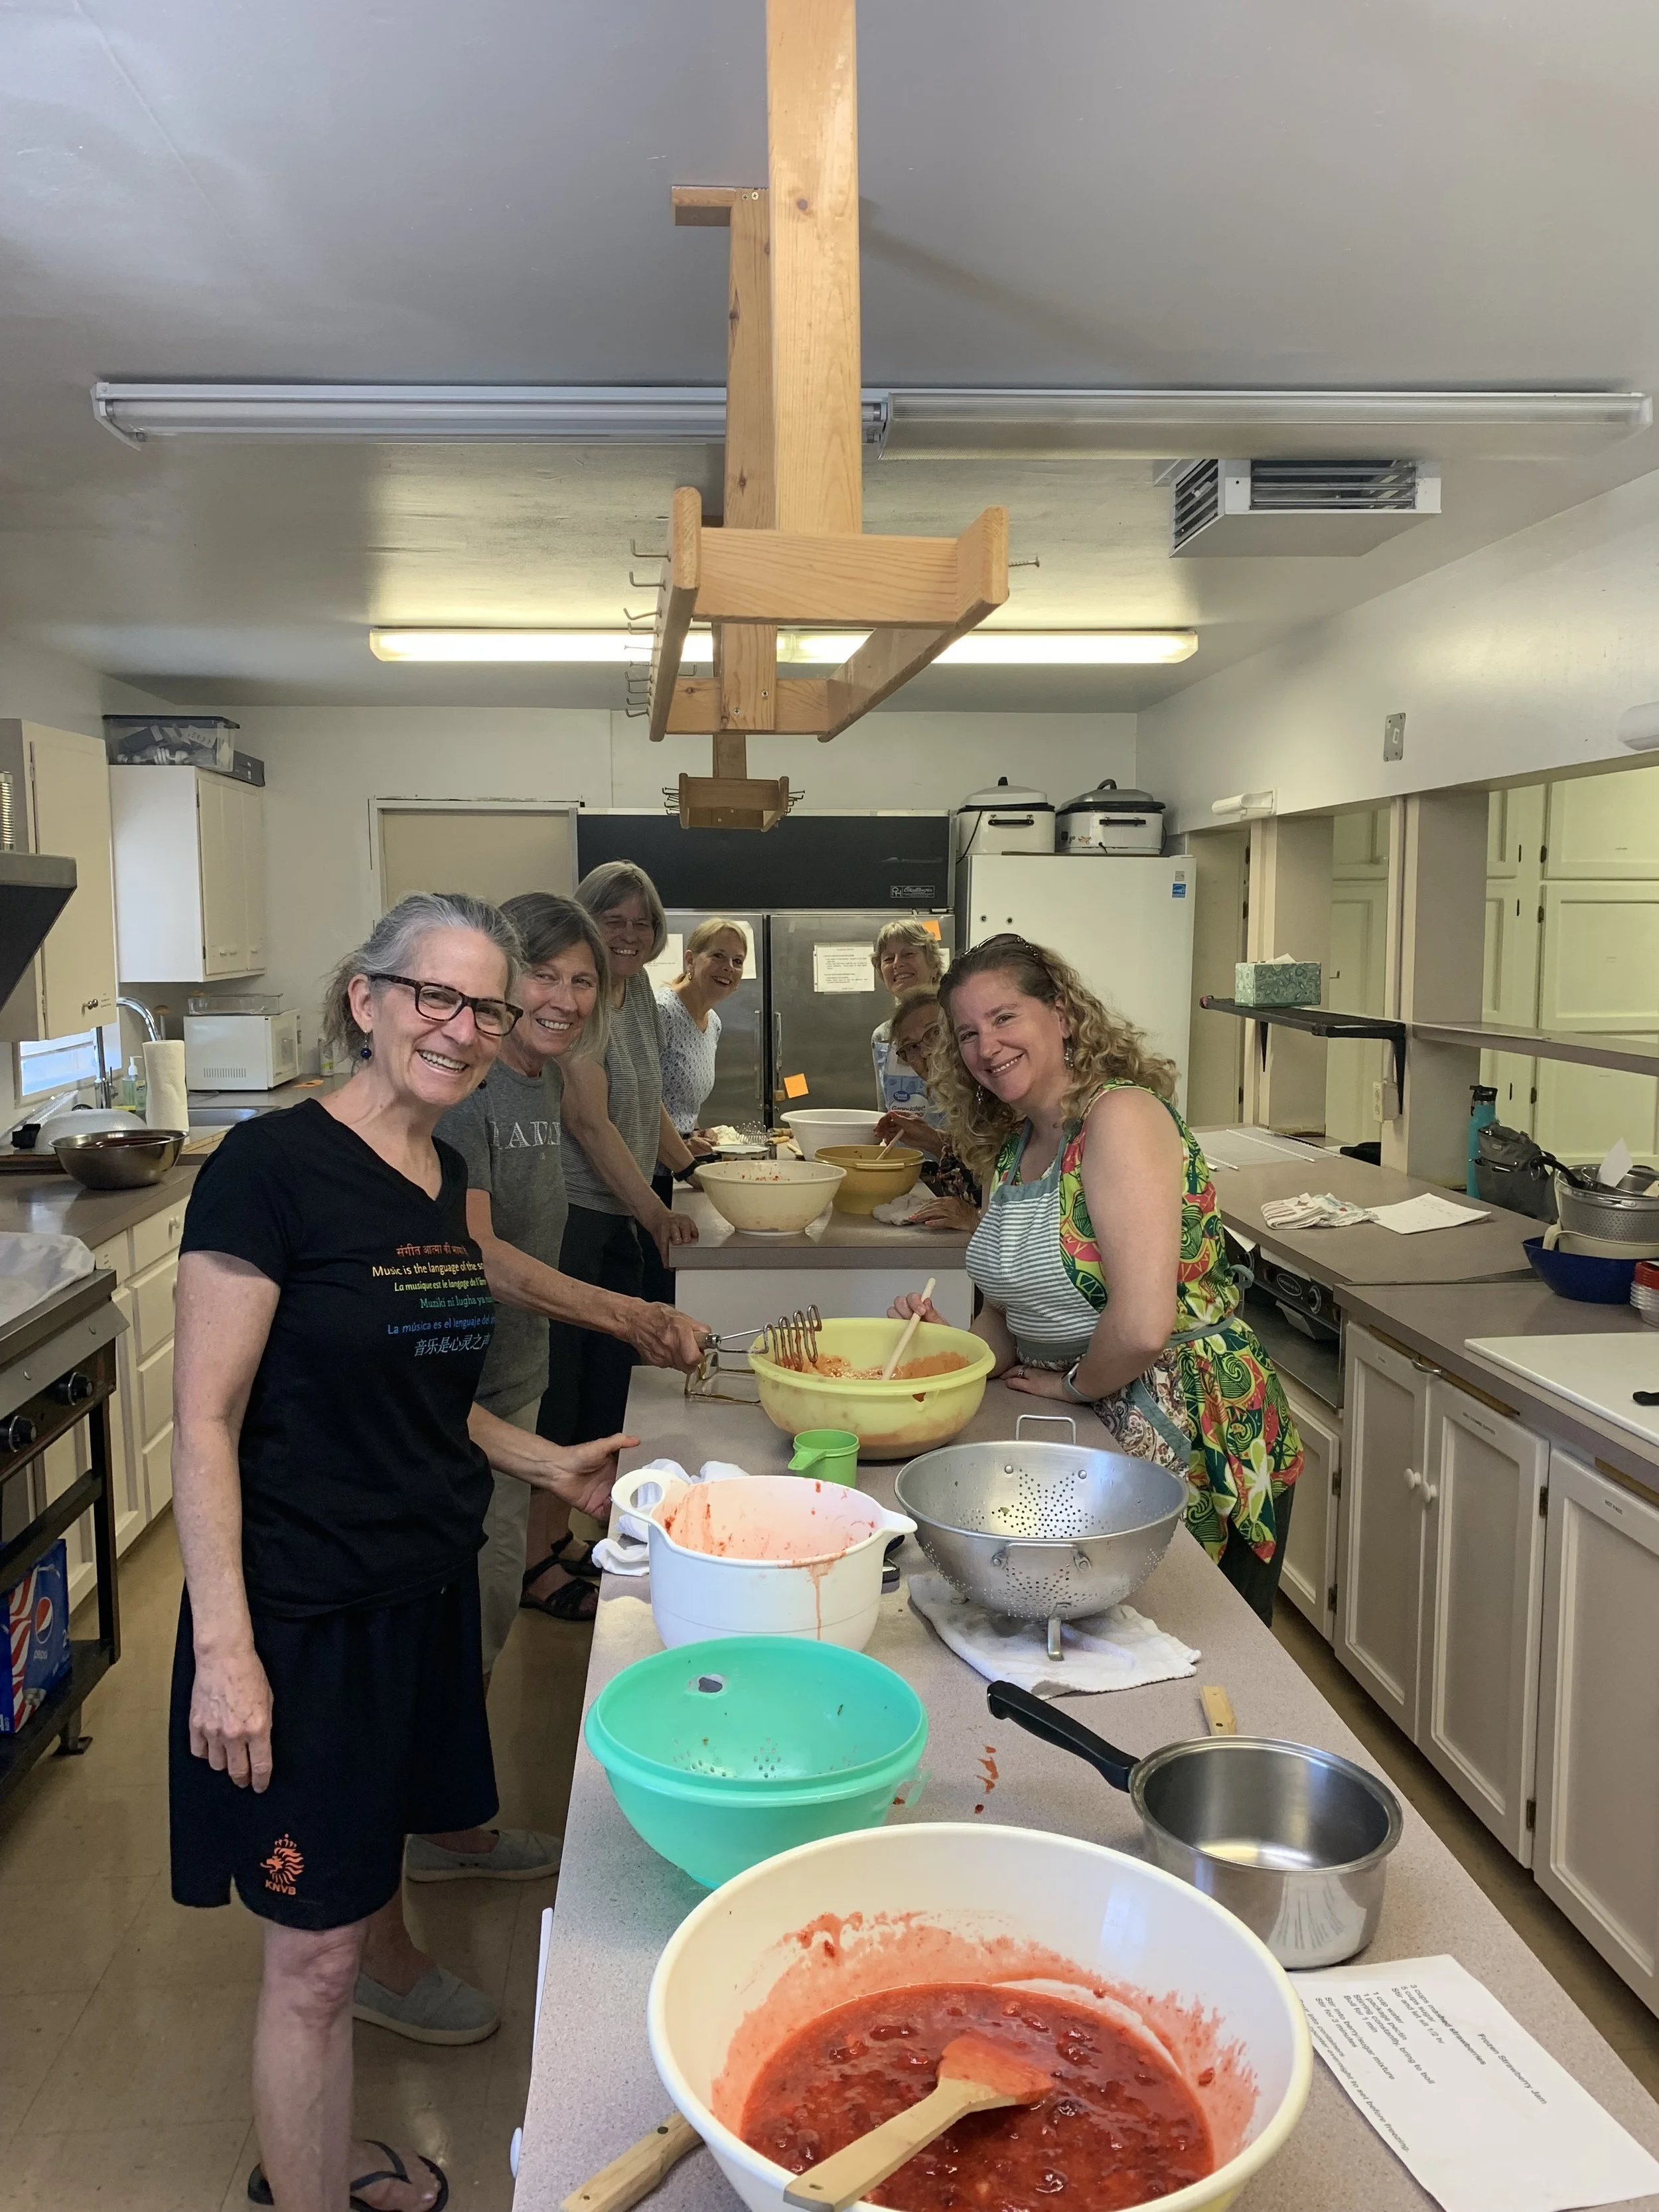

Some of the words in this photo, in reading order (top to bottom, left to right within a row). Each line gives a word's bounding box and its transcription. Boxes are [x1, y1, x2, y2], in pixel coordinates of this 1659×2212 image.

[372, 1266, 402, 1278] Music
[403, 1266, 412, 1275] is
[413, 1263, 428, 1274] the
[428, 1262, 459, 1276] language
[460, 1261, 467, 1272] of
[466, 1260, 477, 1271] the
[394, 1282, 404, 1292] La
[405, 1281, 432, 1291] musique
[442, 1280, 448, 1288] le
[449, 1280, 469, 1290] langage
[470, 1278, 476, 1287] de
[420, 1297, 446, 1309] Muziki
[447, 1297, 455, 1307] ni
[455, 1295, 477, 1307] lugha
[477, 1297, 486, 1306] ya
[388, 1324, 399, 1335] La
[402, 1322, 431, 1333] música
[444, 1317, 452, 1328] el
[453, 1316, 480, 1329] lenguaje
[482, 1313, 490, 1325] del
[414, 1333, 491, 1357] 音乐是心灵之声
[265, 1880, 297, 1895] KNVB
[1315, 1998, 1327, 2008] Stir
[1324, 2008, 1334, 2018] for
[1335, 2024, 1358, 2048] minutes
[1344, 1995, 1357, 2007] Boil
[1354, 2007, 1364, 2017] for
[1366, 2022, 1378, 2033] min
[1365, 1998, 1391, 2022] package
[1387, 2022, 1407, 2041] pectin
[1376, 1996, 1388, 2008] cup
[1387, 2008, 1404, 2024] water
[1392, 1988, 1404, 1998] Stir
[1401, 1999, 1414, 2011] and
[1411, 2010, 1421, 2019] let
[1427, 2028, 1439, 2037] 1/2
[1405, 1990, 1419, 2006] cups
[1418, 2006, 1436, 2022] sugar
[1307, 2012, 1319, 2026] into
[1317, 2025, 1345, 2057] containers
[1325, 1996, 1336, 2008] Stir
[1334, 2008, 1345, 2020] into
[1344, 2021, 1375, 2055] berry/sugar
[1372, 2056, 1395, 2080] mixture
[1353, 1994, 1373, 2016] Stirring
[1372, 2015, 1400, 2047] constantly,
[1399, 2047, 1415, 2064] bring
[1420, 2072, 1435, 2085] boil
[1415, 1989, 1429, 2004] cups
[1427, 2004, 1453, 2028] mashed
[1449, 2028, 1486, 2065] strawberries
[1327, 2049, 1354, 2080] overnight
[1357, 2089, 1369, 2100] set
[1366, 2101, 1386, 2123] before
[1477, 2033, 1499, 2054] Frozen
[1498, 2055, 1533, 2089] Strawberry
[1531, 2089, 1547, 2104] Jam
